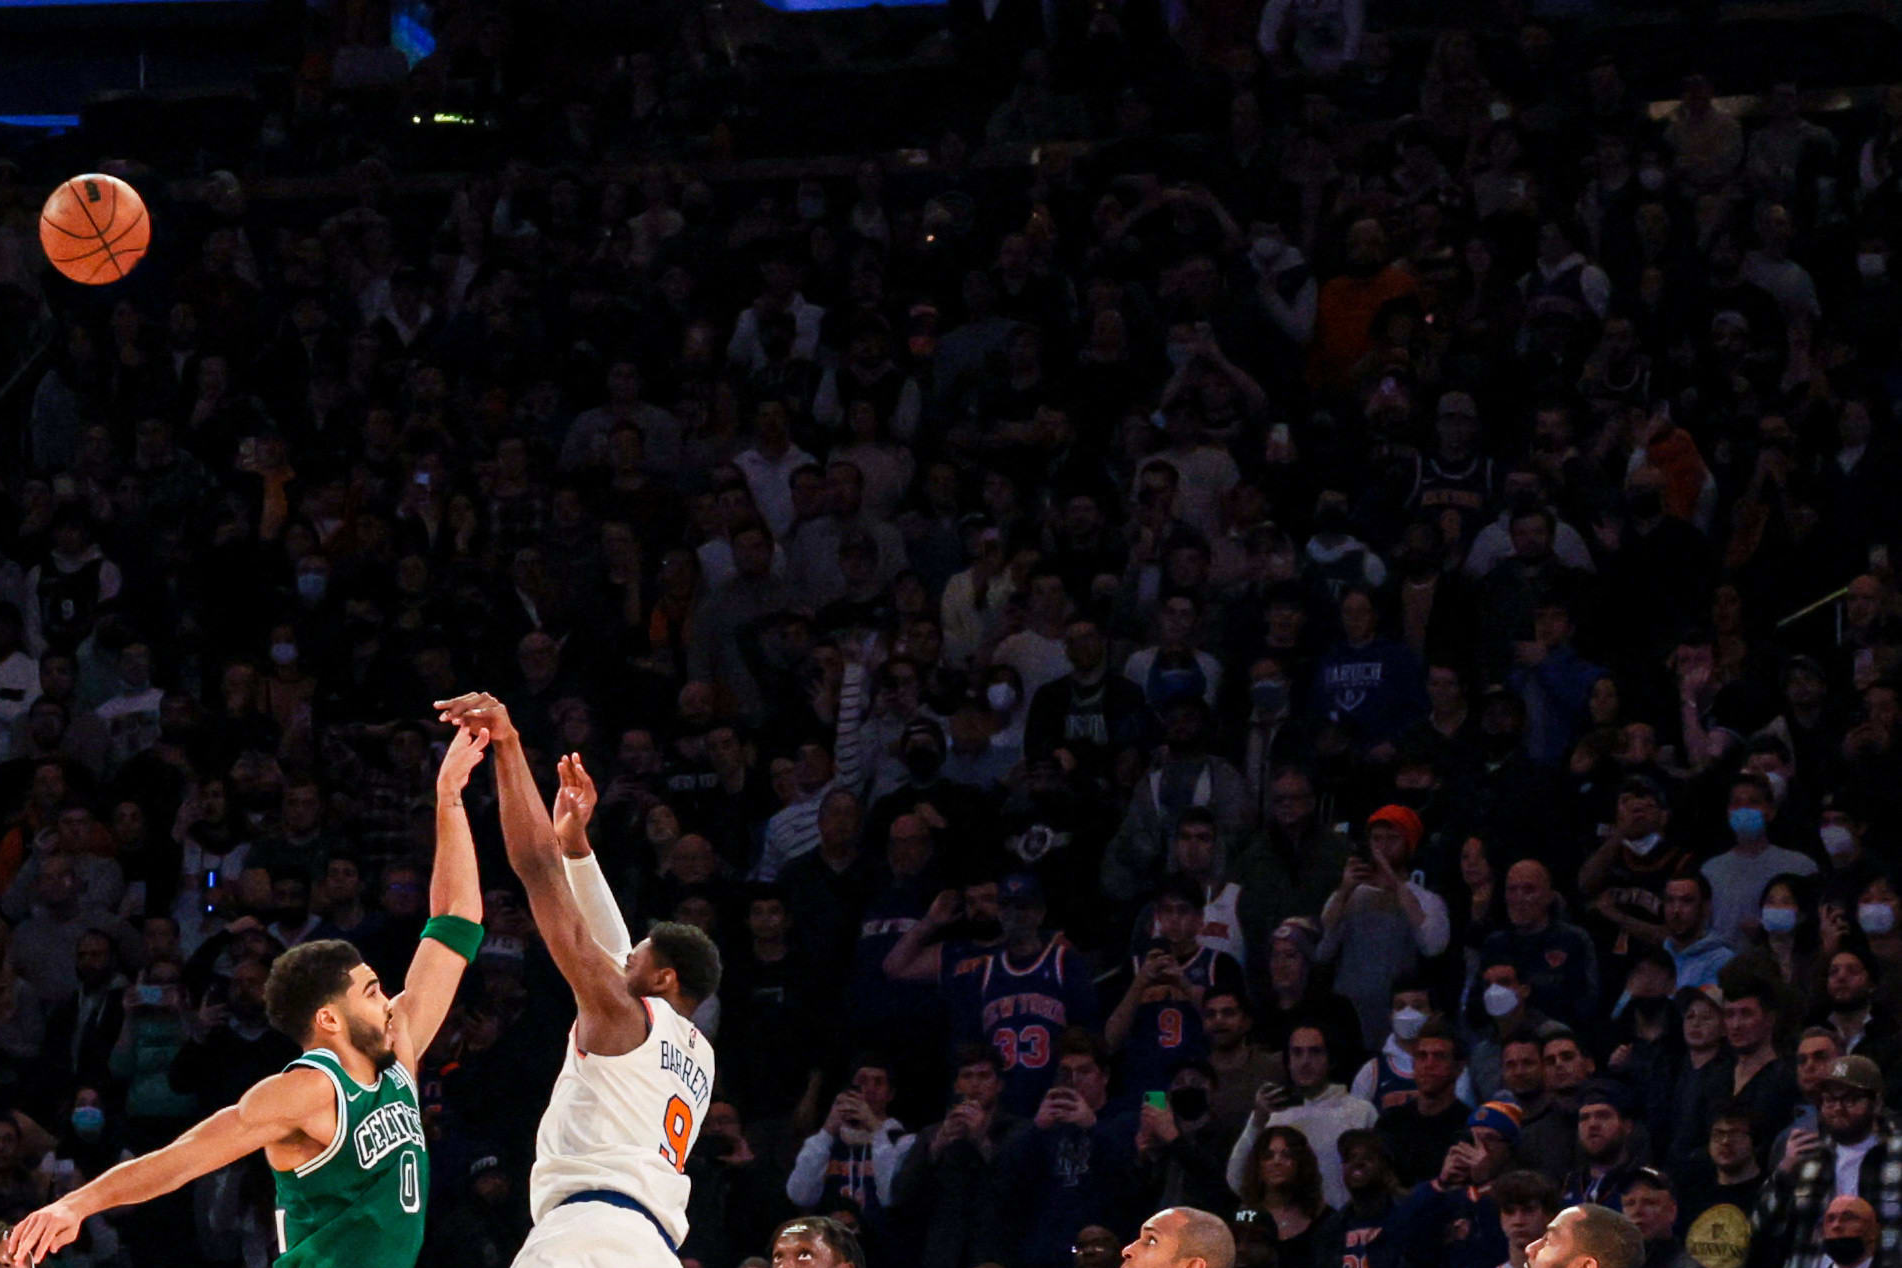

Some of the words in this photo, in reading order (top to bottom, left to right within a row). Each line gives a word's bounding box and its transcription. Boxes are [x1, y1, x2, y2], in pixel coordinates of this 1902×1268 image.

[992, 1023, 1051, 1071] 33
[1157, 1007, 1184, 1048] 9
[660, 1040, 711, 1109] BARRETT
[658, 1094, 693, 1174] 9
[399, 1150, 421, 1213] 0
